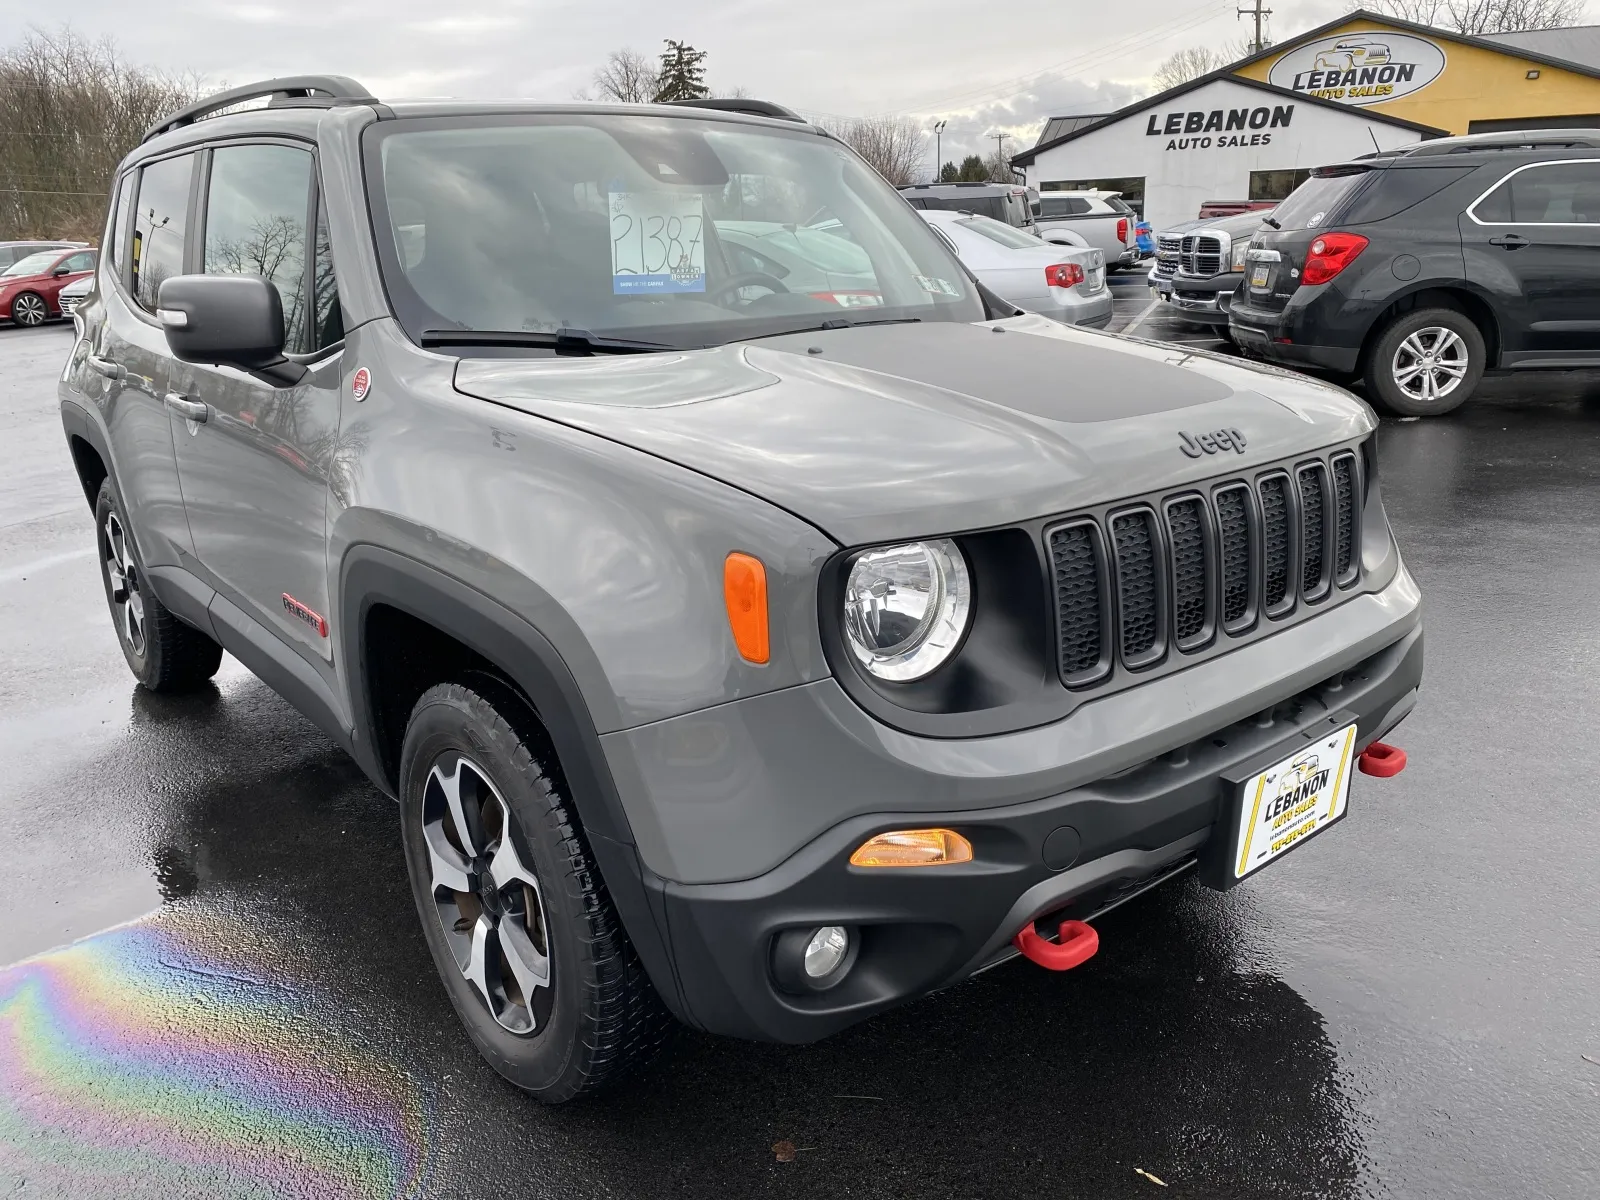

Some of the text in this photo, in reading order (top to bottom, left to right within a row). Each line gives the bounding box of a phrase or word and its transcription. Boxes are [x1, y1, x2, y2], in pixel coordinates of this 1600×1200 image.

[1292, 64, 1416, 90] LEBANON
[1348, 84, 1394, 97] SALES
[1146, 105, 1294, 136] LEBANON
[1166, 133, 1272, 151] AUTO SALES
[1178, 427, 1248, 459] Jeep
[1264, 768, 1330, 823] LEBANON
[1271, 795, 1318, 831] AUTO SALES
